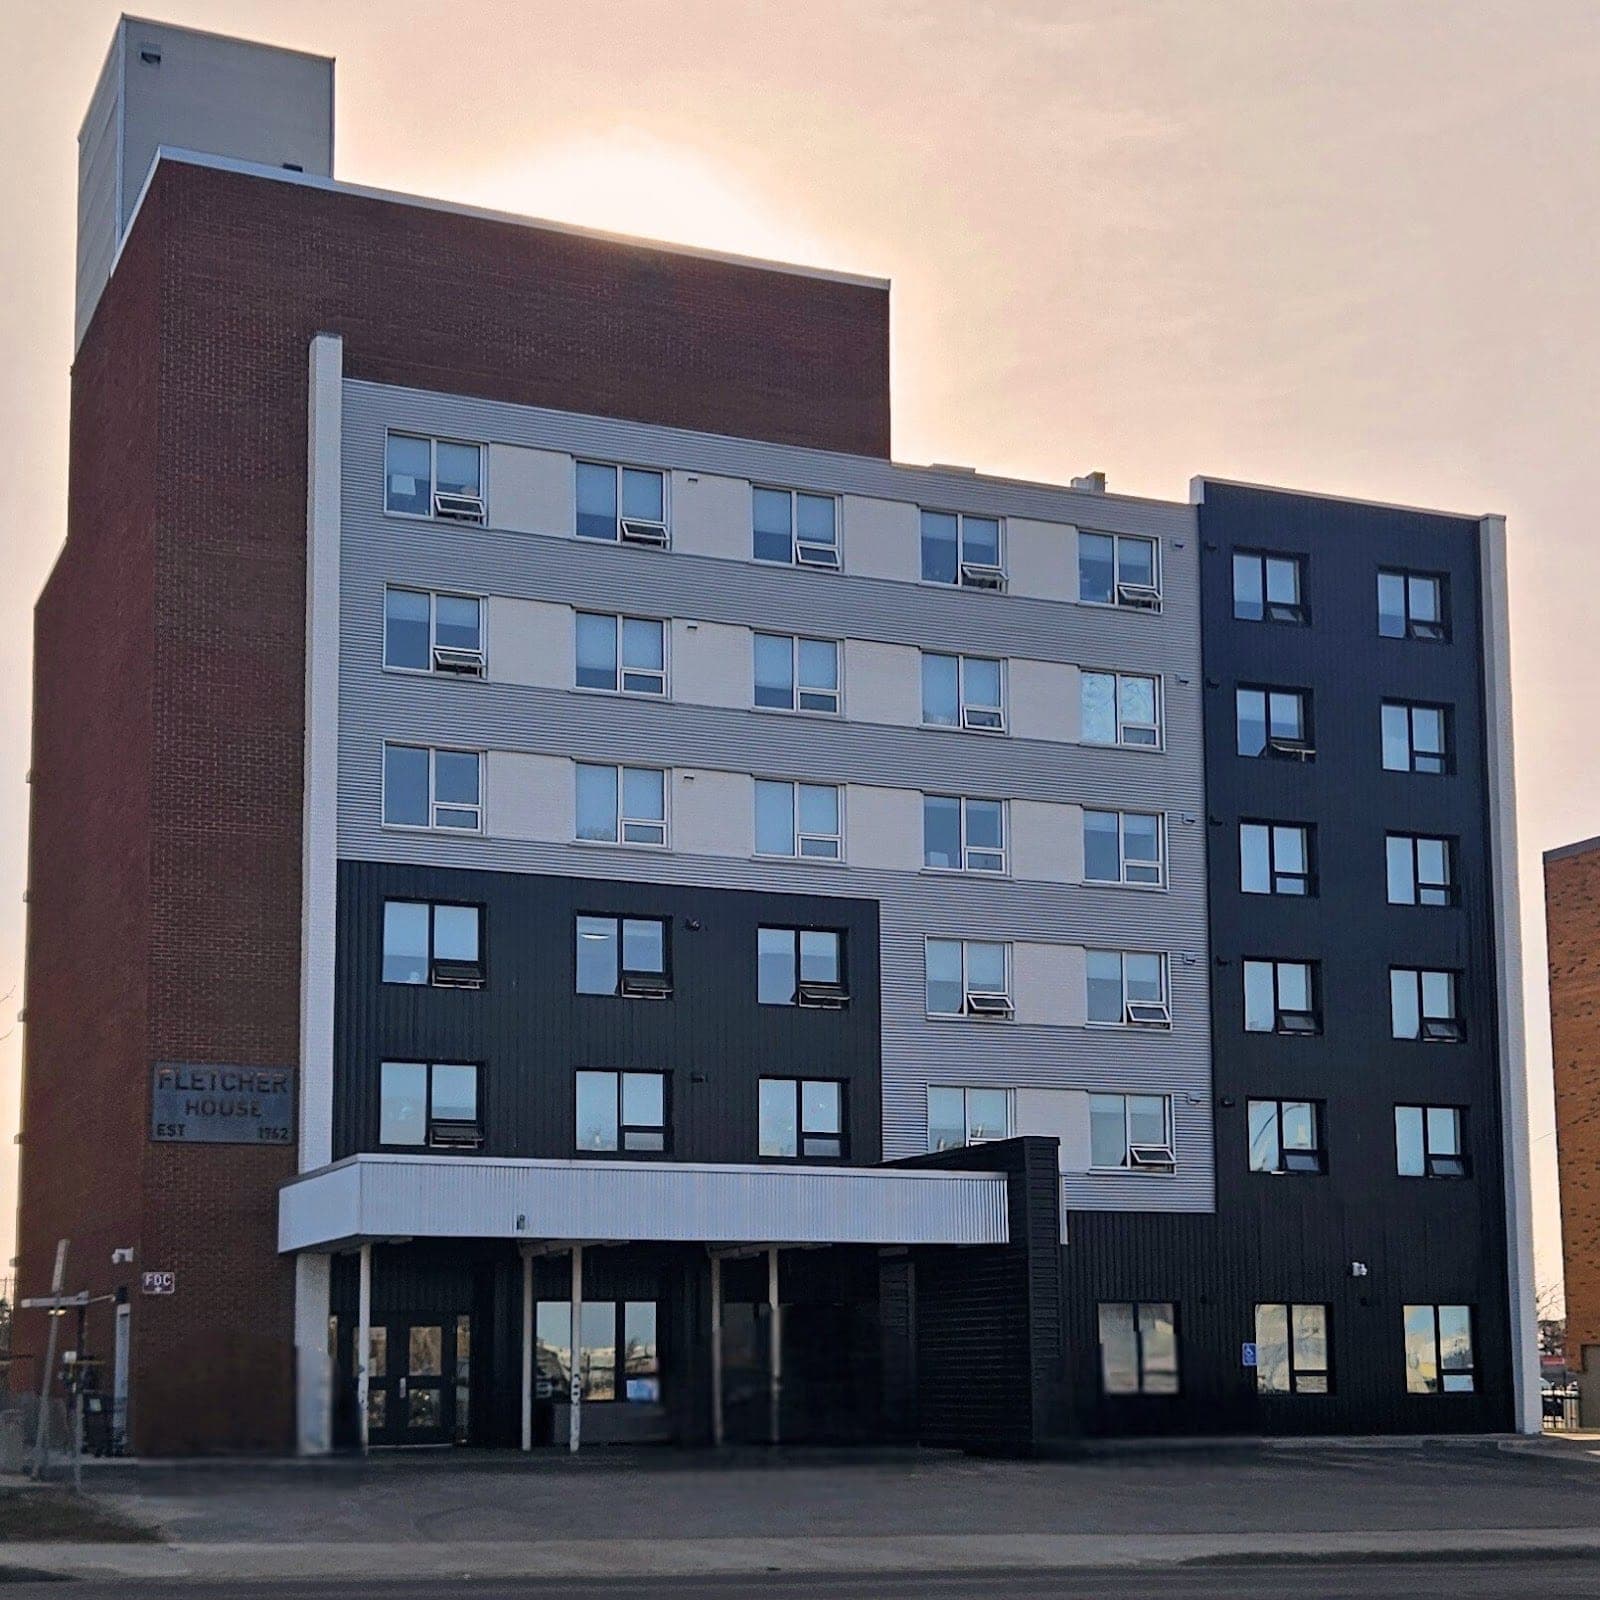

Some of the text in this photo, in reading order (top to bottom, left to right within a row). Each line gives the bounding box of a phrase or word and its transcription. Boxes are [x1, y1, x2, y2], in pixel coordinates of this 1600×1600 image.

[159, 1069, 288, 1092] FLETCHER
[184, 1100, 262, 1117] HOUSE
[145, 1274, 171, 1286] FDC
